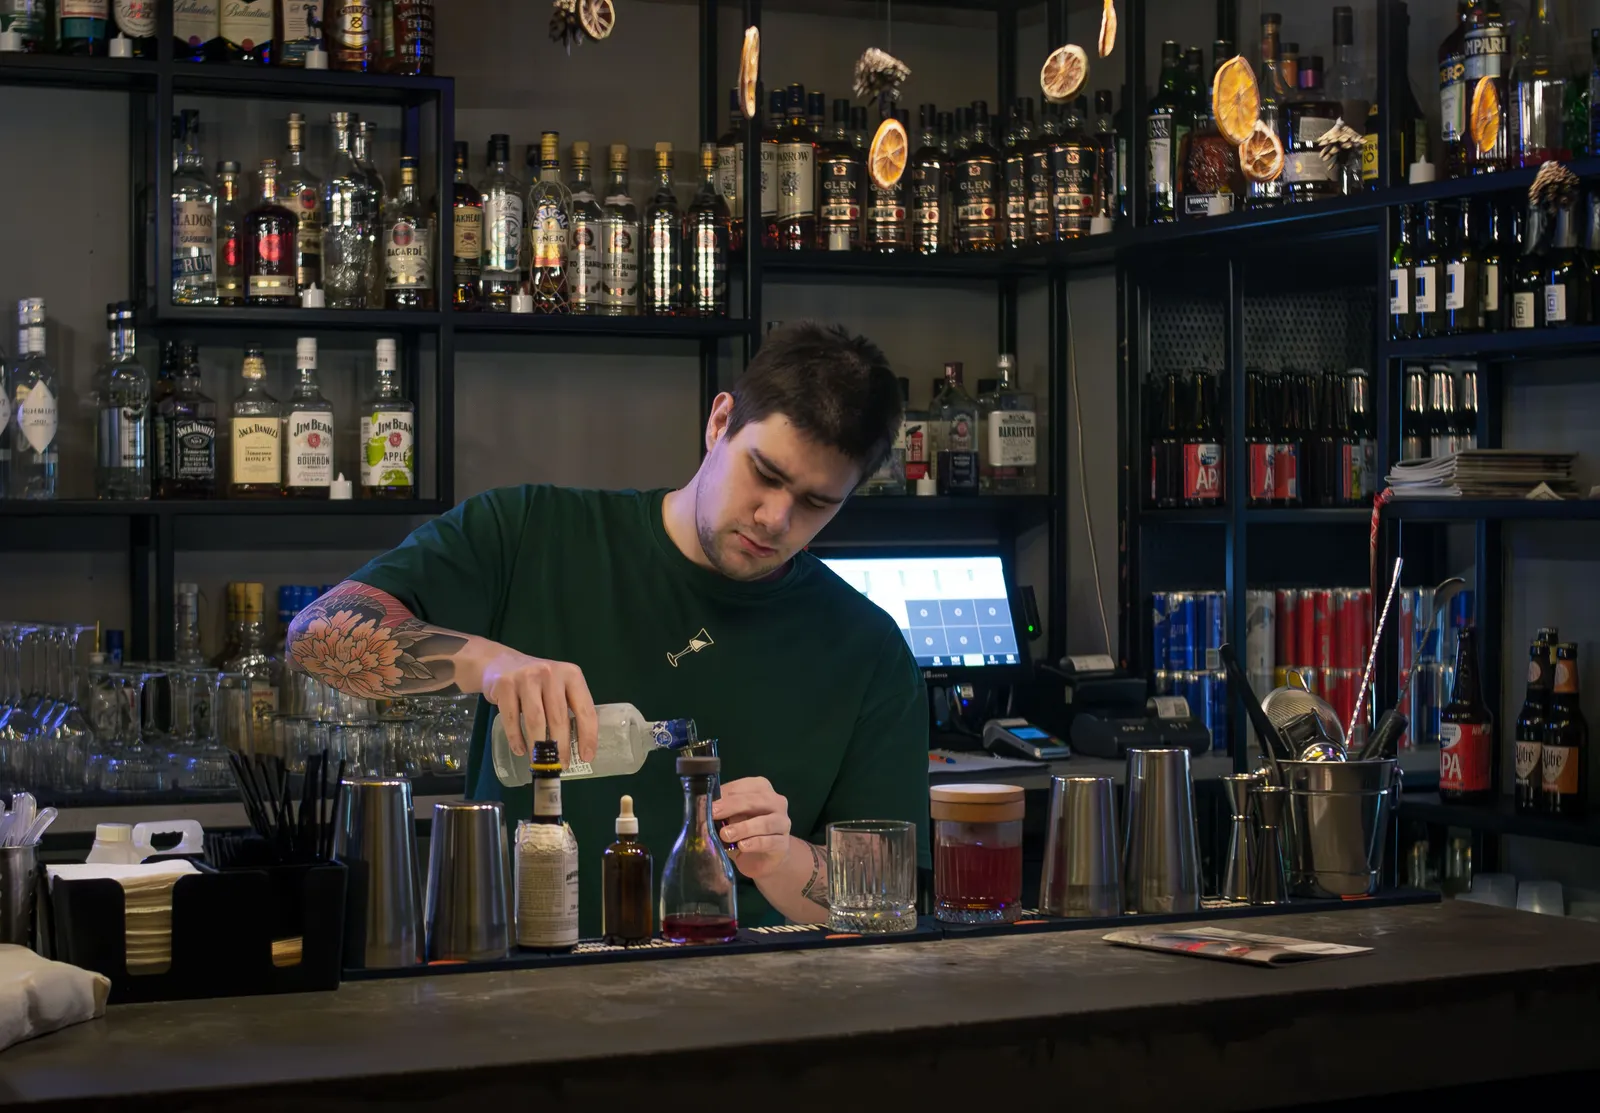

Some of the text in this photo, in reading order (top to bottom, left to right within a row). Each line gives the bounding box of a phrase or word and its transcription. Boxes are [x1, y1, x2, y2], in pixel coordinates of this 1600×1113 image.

[340, 6, 373, 15] CHIVAS
[1465, 37, 1508, 55] MPARI
[1031, 174, 1048, 185] GL
[1056, 169, 1090, 179] GLEN
[824, 180, 857, 190] GLEN
[913, 184, 936, 193] LEN
[960, 180, 992, 190] GLEN
[533, 208, 568, 230] BRUGAL
[387, 246, 423, 256] BACARDÍ
[177, 424, 193, 438] JACK
[238, 426, 253, 438] JACK
[294, 419, 333, 438] JIM BEAM
[376, 421, 391, 436] JIM
[297, 456, 330, 465] BOURBON
[383, 451, 407, 462] APPLE
